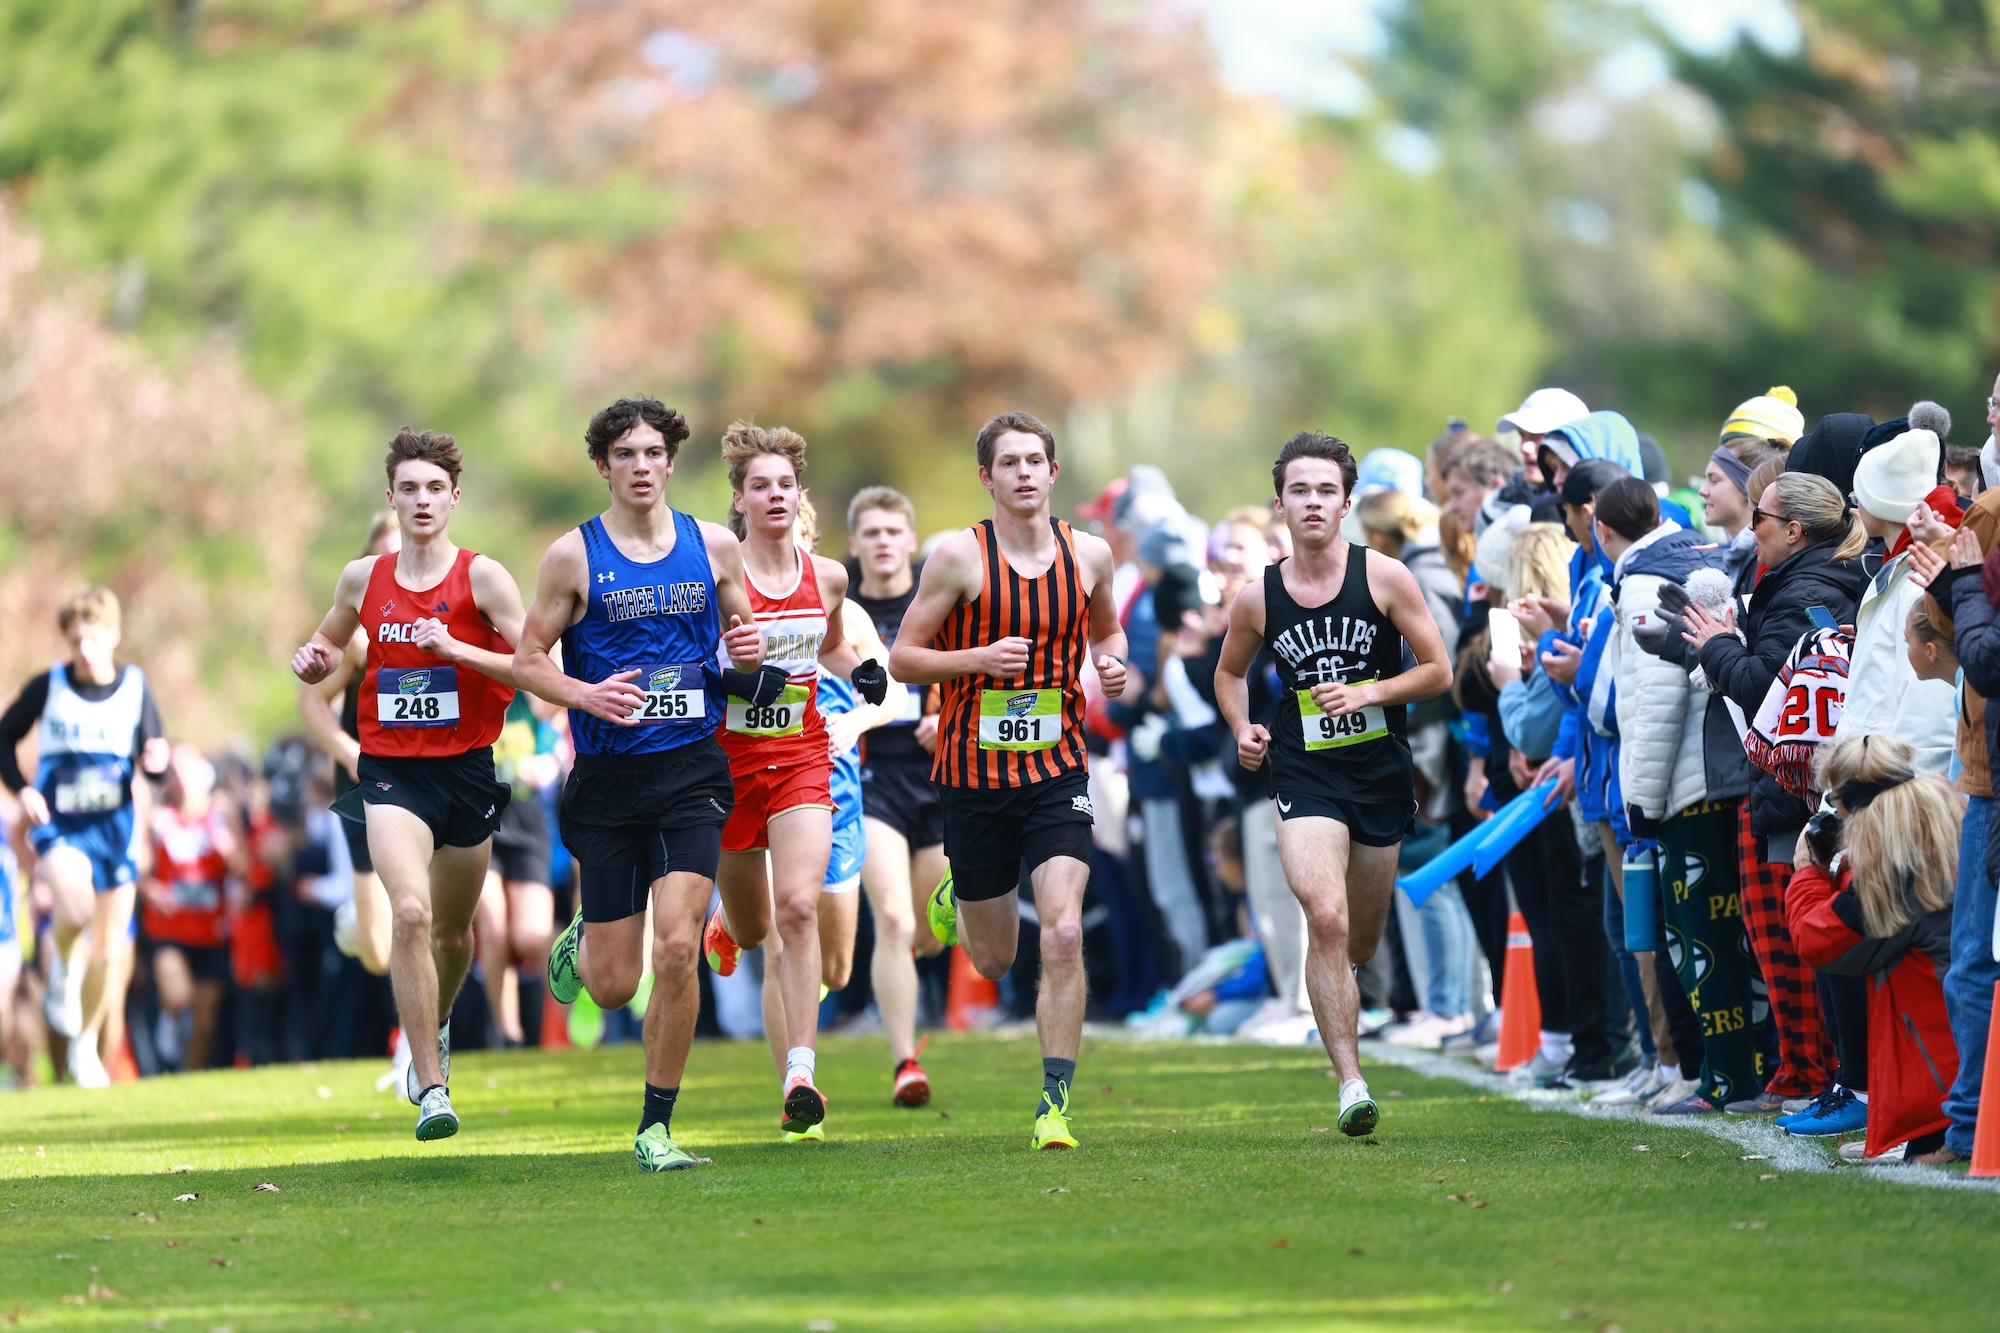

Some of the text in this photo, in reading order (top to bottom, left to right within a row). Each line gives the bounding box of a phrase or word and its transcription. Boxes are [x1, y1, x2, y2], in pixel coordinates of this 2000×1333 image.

[602, 582, 706, 622] THREE LAKES
[765, 632, 824, 661] RDIANS
[1272, 616, 1378, 669] PHILLIPS
[406, 675, 424, 683] CROSS
[1316, 655, 1348, 684] CC
[394, 697, 440, 719] 248
[643, 694, 688, 717] 255
[1013, 696, 1032, 705] CROSS
[745, 707, 791, 729] 980
[998, 718, 1041, 742] 961
[1319, 711, 1367, 739] 949
